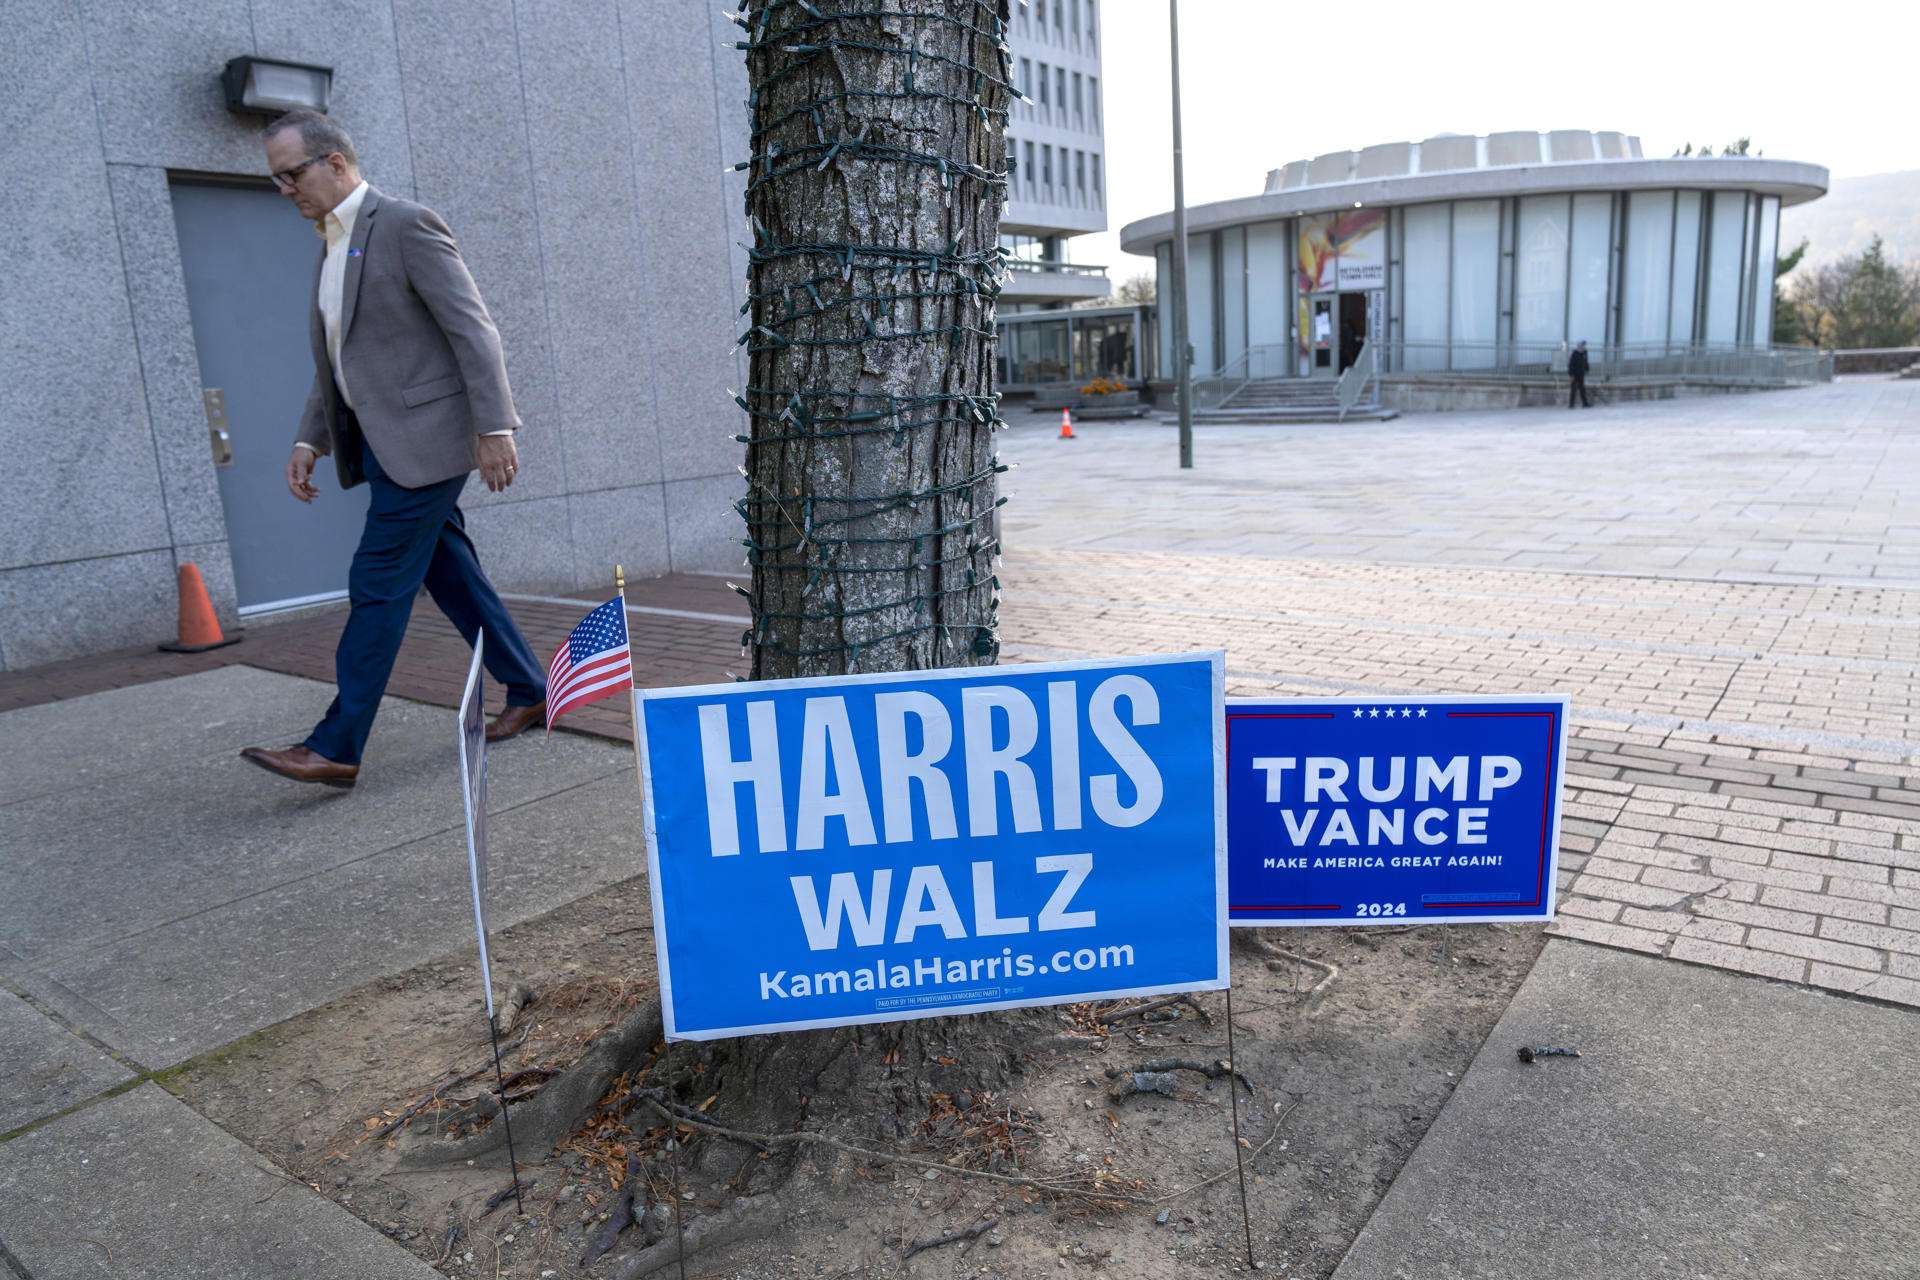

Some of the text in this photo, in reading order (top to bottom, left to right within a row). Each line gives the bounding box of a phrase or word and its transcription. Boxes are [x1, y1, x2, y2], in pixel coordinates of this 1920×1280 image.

[698, 674, 1163, 857] HARRIS
[1253, 756, 1522, 802] TRUMP
[1281, 808, 1489, 846] VANCE
[1263, 855, 1502, 869] MAKE AMERICA GREAT AGAIN!
[790, 853, 1097, 951] WALZ
[1356, 903, 1407, 916] 2024
[760, 945, 1134, 999] KamalaHarris.com
